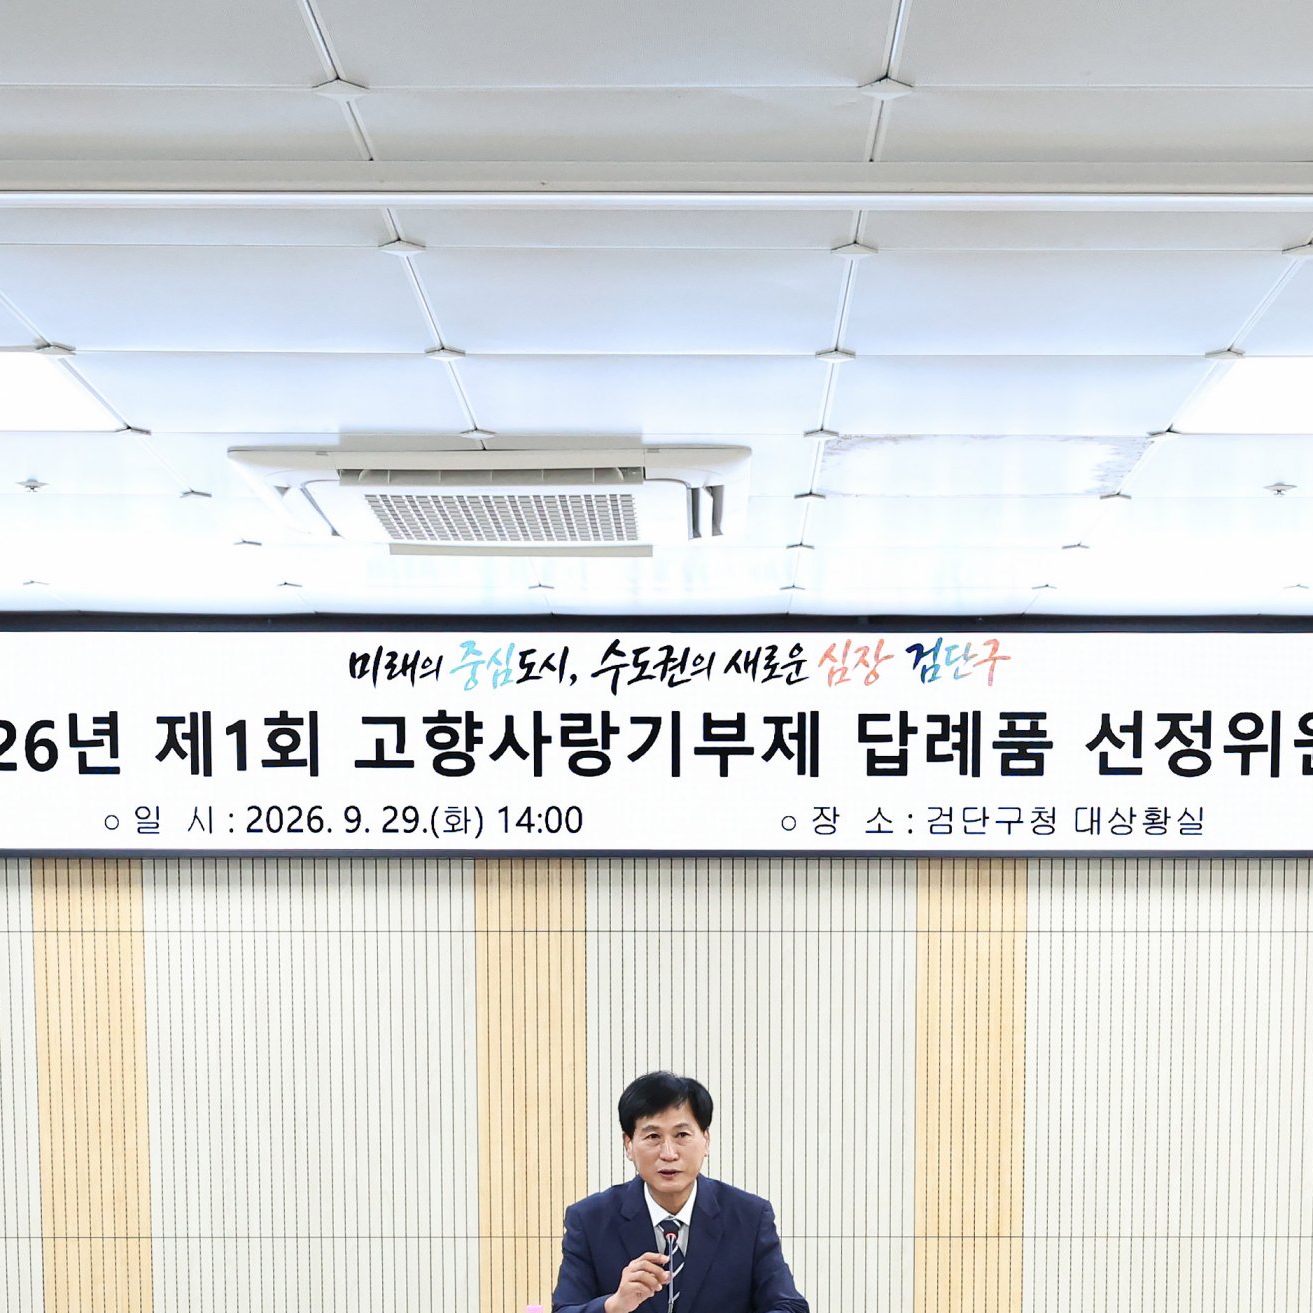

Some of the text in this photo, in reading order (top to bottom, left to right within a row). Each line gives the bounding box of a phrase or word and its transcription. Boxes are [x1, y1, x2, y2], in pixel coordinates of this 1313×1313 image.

[348, 636, 1012, 697] 미래의 중심도시, 수도권의 새로운 심장 검단구
[154, 710, 319, 778] 제1회
[354, 709, 820, 778] 고향사랑기부제
[857, 710, 1054, 778] 답례품
[246, 805, 332, 834] 2026.
[343, 805, 370, 834] 9.
[382, 805, 484, 839] 29.(화)
[498, 805, 583, 834] 14:00
[927, 806, 1056, 836] 검단구청
[1074, 806, 1203, 836] 대상황실
